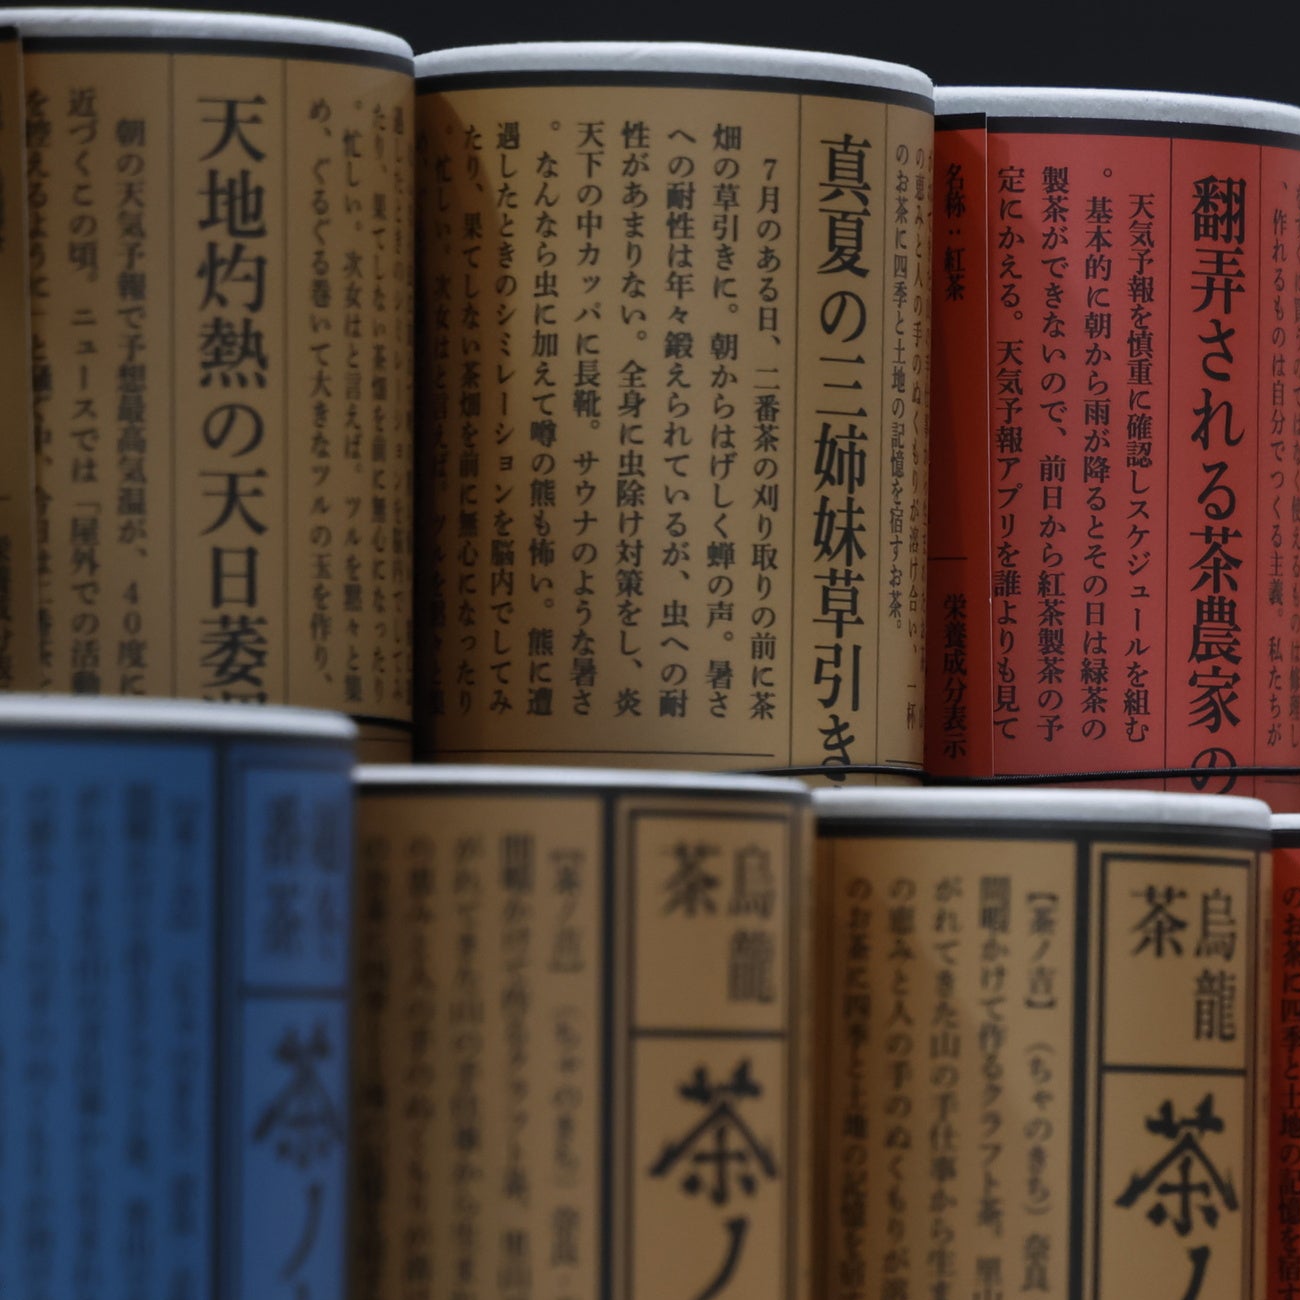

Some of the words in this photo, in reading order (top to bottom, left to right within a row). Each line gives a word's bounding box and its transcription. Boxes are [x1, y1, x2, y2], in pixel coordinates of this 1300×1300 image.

[196, 94, 270, 703] 天地灼熱の天日萎
[571, 121, 606, 717] 天下の中カッパに長靴。サウナのような暑さ
[613, 120, 650, 718] 性があまりない。全身に虫除け対策をし、炎
[659, 125, 697, 719] への耐性は年々鍛えられているが、虫への耐
[704, 122, 742, 719] 畑の草引きに。朝からはげしく蝉の声。暑さ
[811, 133, 872, 782] 真夏の三姉妹草引き
[942, 592, 969, 760] 栄養成分表示
[993, 165, 1026, 740] 定にかえる。天気予報アプリを誰よりも見て
[1036, 165, 1071, 743] 製茶ができないので、前日から紅茶製茶の予
[1078, 167, 1114, 741] 。基本的に朝から雨が降るとその日は緑茶の
[1123, 192, 1156, 744] 天気予報を慎重に確認しスケジュールを組む
[1187, 174, 1246, 795] 翻弄される茶農家の
[1131, 885, 1188, 960] 茶
[1193, 888, 1237, 1042] 烏龍
